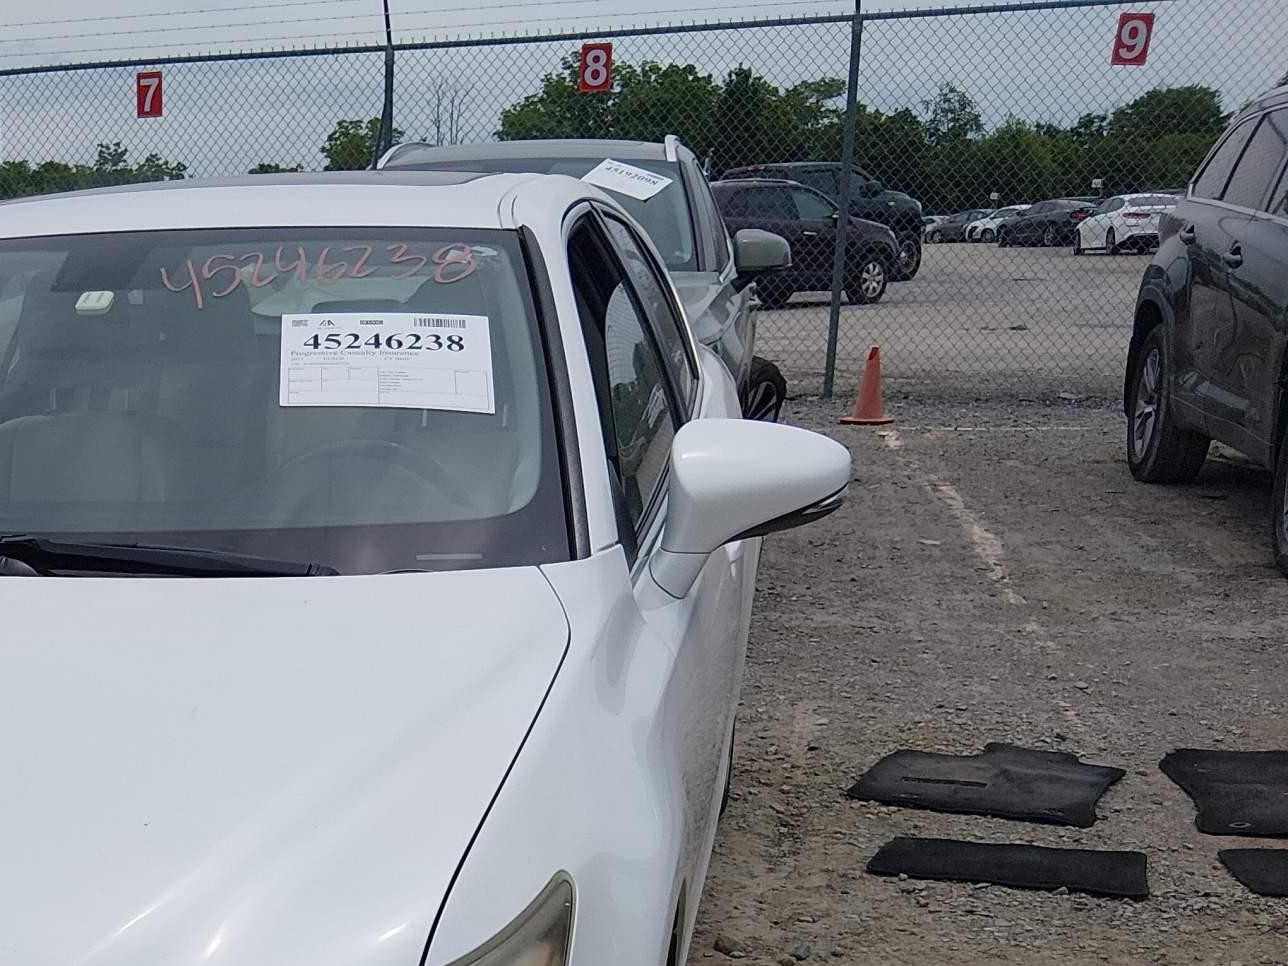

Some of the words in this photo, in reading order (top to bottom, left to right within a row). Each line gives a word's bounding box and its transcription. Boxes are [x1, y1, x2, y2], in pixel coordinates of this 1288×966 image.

[1119, 19, 1147, 59] 9
[584, 49, 607, 86] 8
[139, 77, 160, 112] 7
[160, 242, 478, 309] 45246238
[303, 333, 465, 352] 45246238
